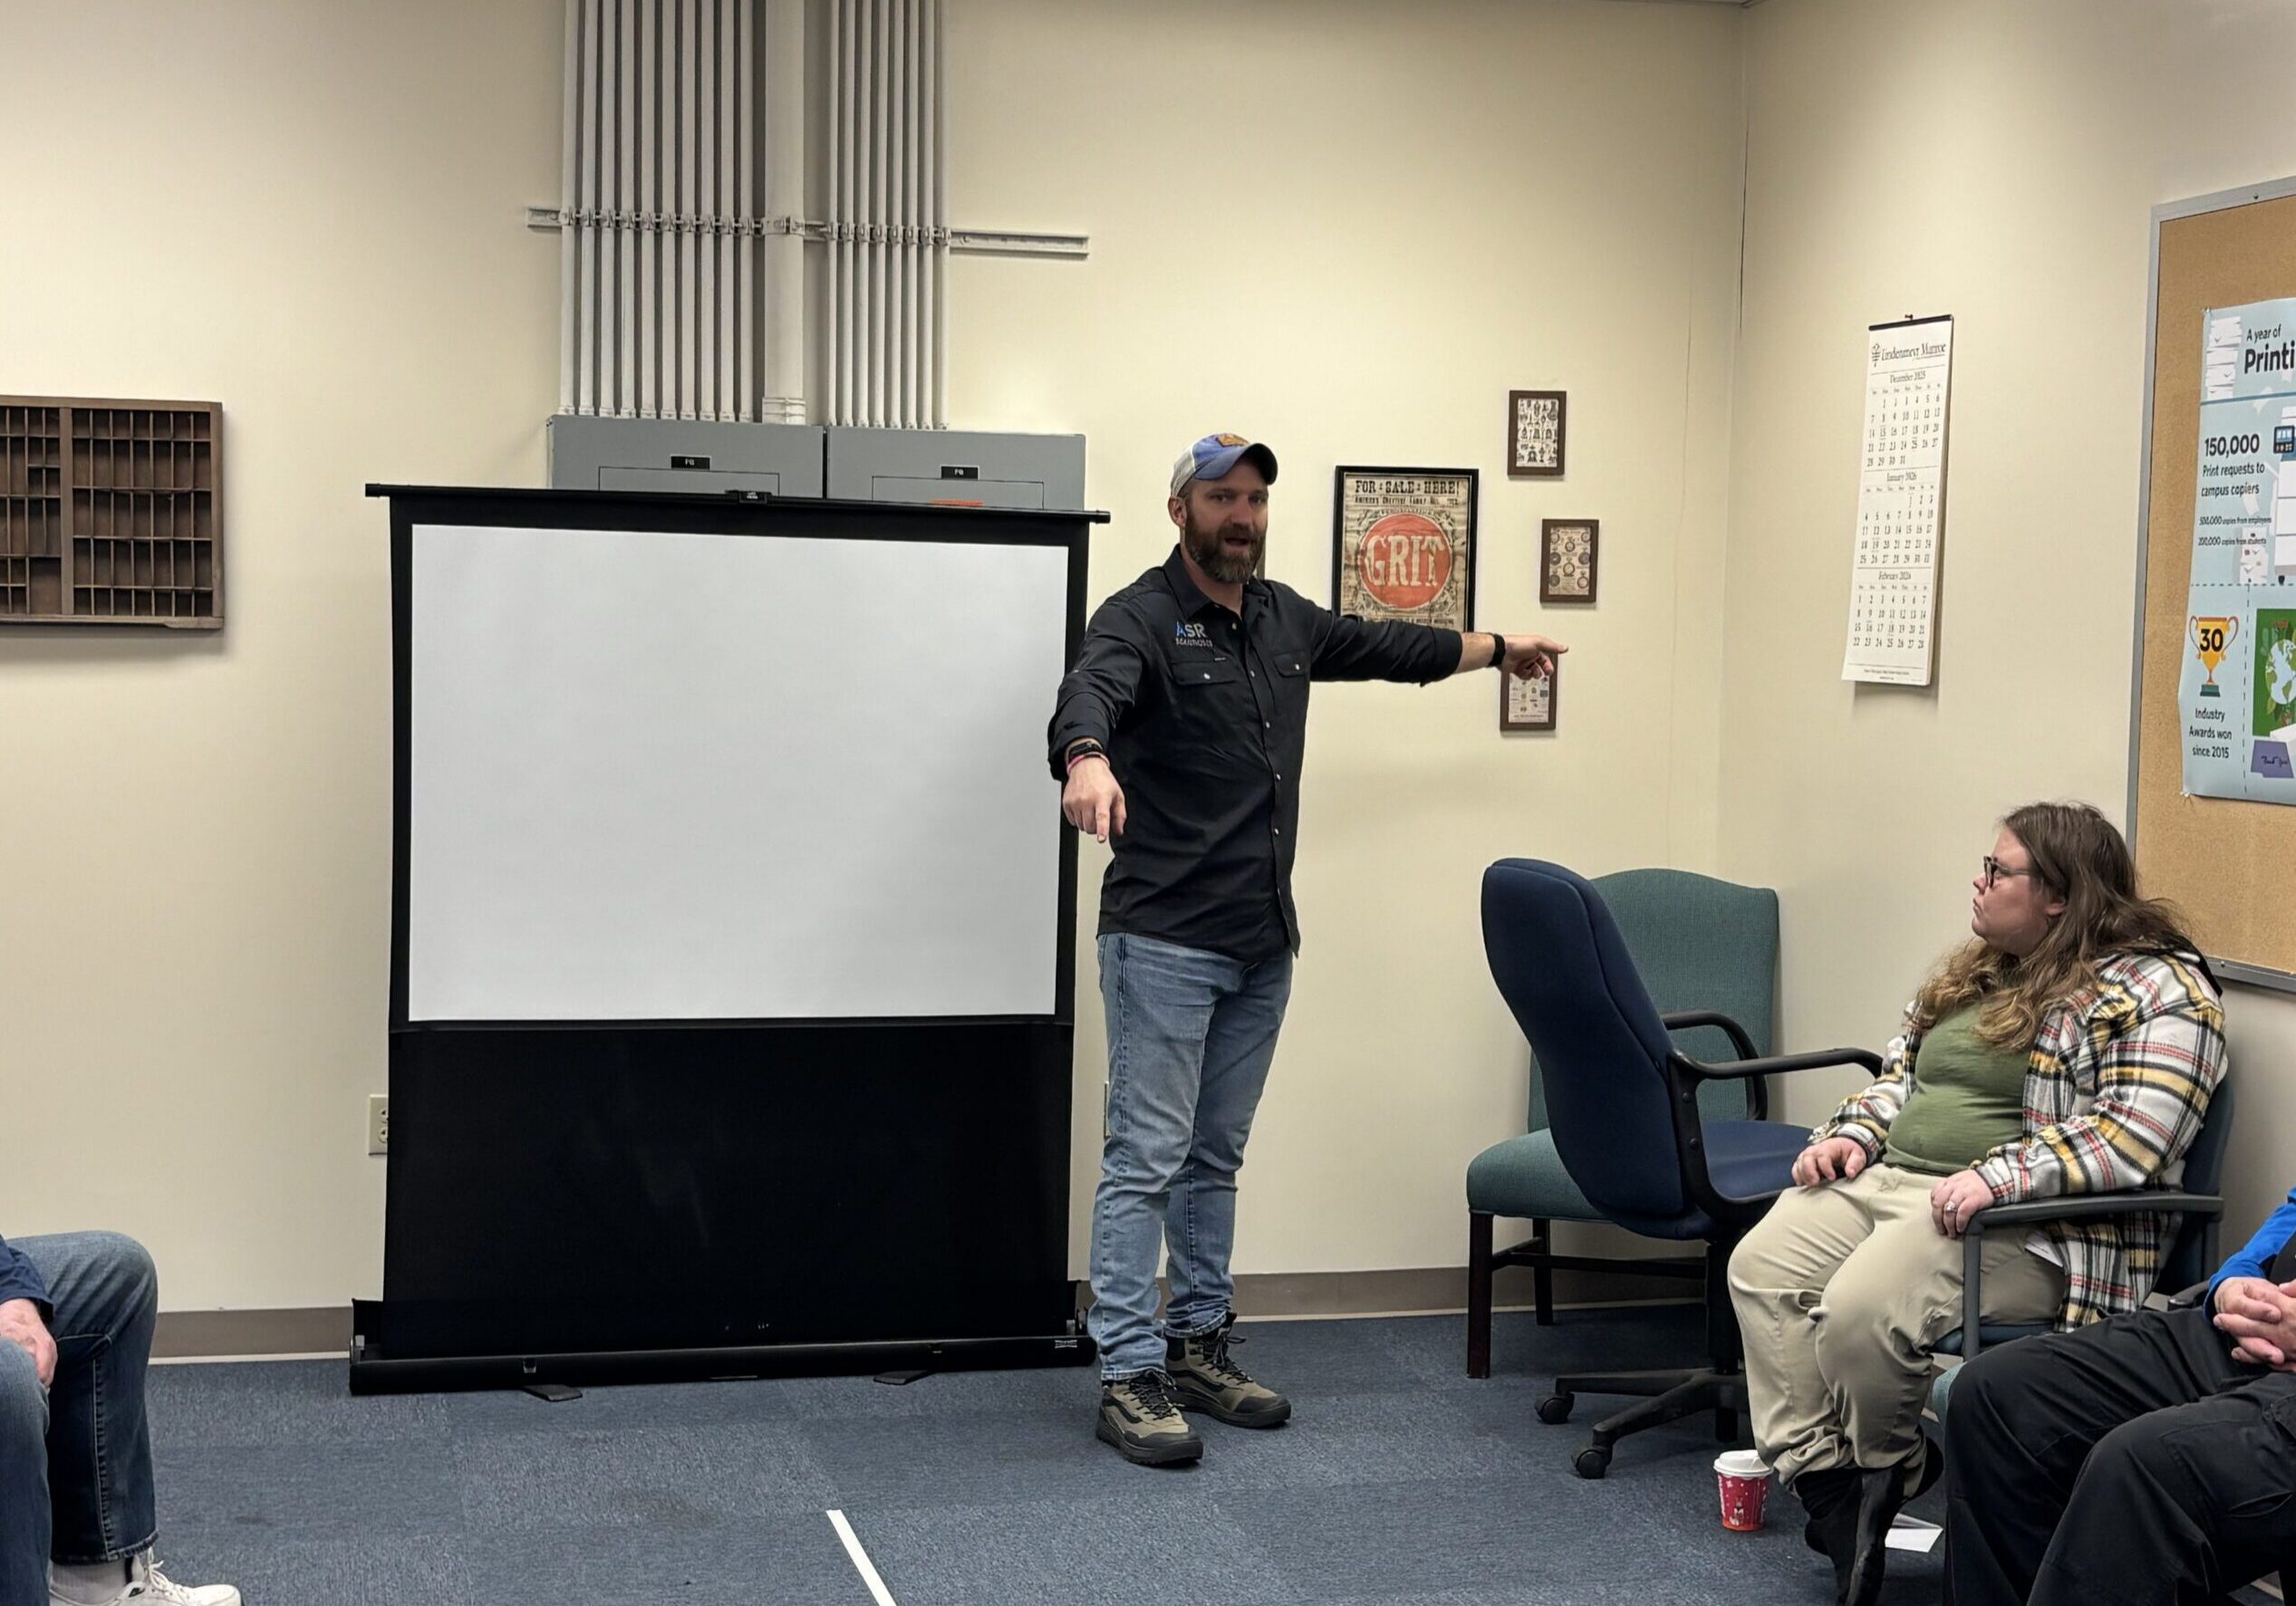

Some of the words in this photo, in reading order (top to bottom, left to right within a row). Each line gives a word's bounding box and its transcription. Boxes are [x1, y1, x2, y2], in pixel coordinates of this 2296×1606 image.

[2246, 329, 2253, 341] A
[2254, 329, 2272, 343] year
[2272, 323, 2282, 338] of
[2244, 340, 2295, 374] Printi
[2204, 434, 2261, 458] 150,000
[2202, 464, 2219, 477] Print
[2221, 463, 2254, 478] requests
[2256, 462, 2265, 474] to
[1355, 480, 1376, 494] FOR
[1385, 480, 1414, 494] SALE
[1423, 481, 1460, 495] HERE!
[2201, 486, 2229, 499] campus
[2231, 482, 2259, 497] copiers
[1365, 534, 1445, 587] GRIT
[1174, 621, 1208, 638] ASR
[2199, 628, 2224, 652] 30
[2195, 707, 2225, 723] Industry
[2189, 726, 2215, 739] Awards
[2216, 730, 2233, 739] won
[2193, 745, 2211, 756] since
[2212, 746, 2230, 758] 2015
